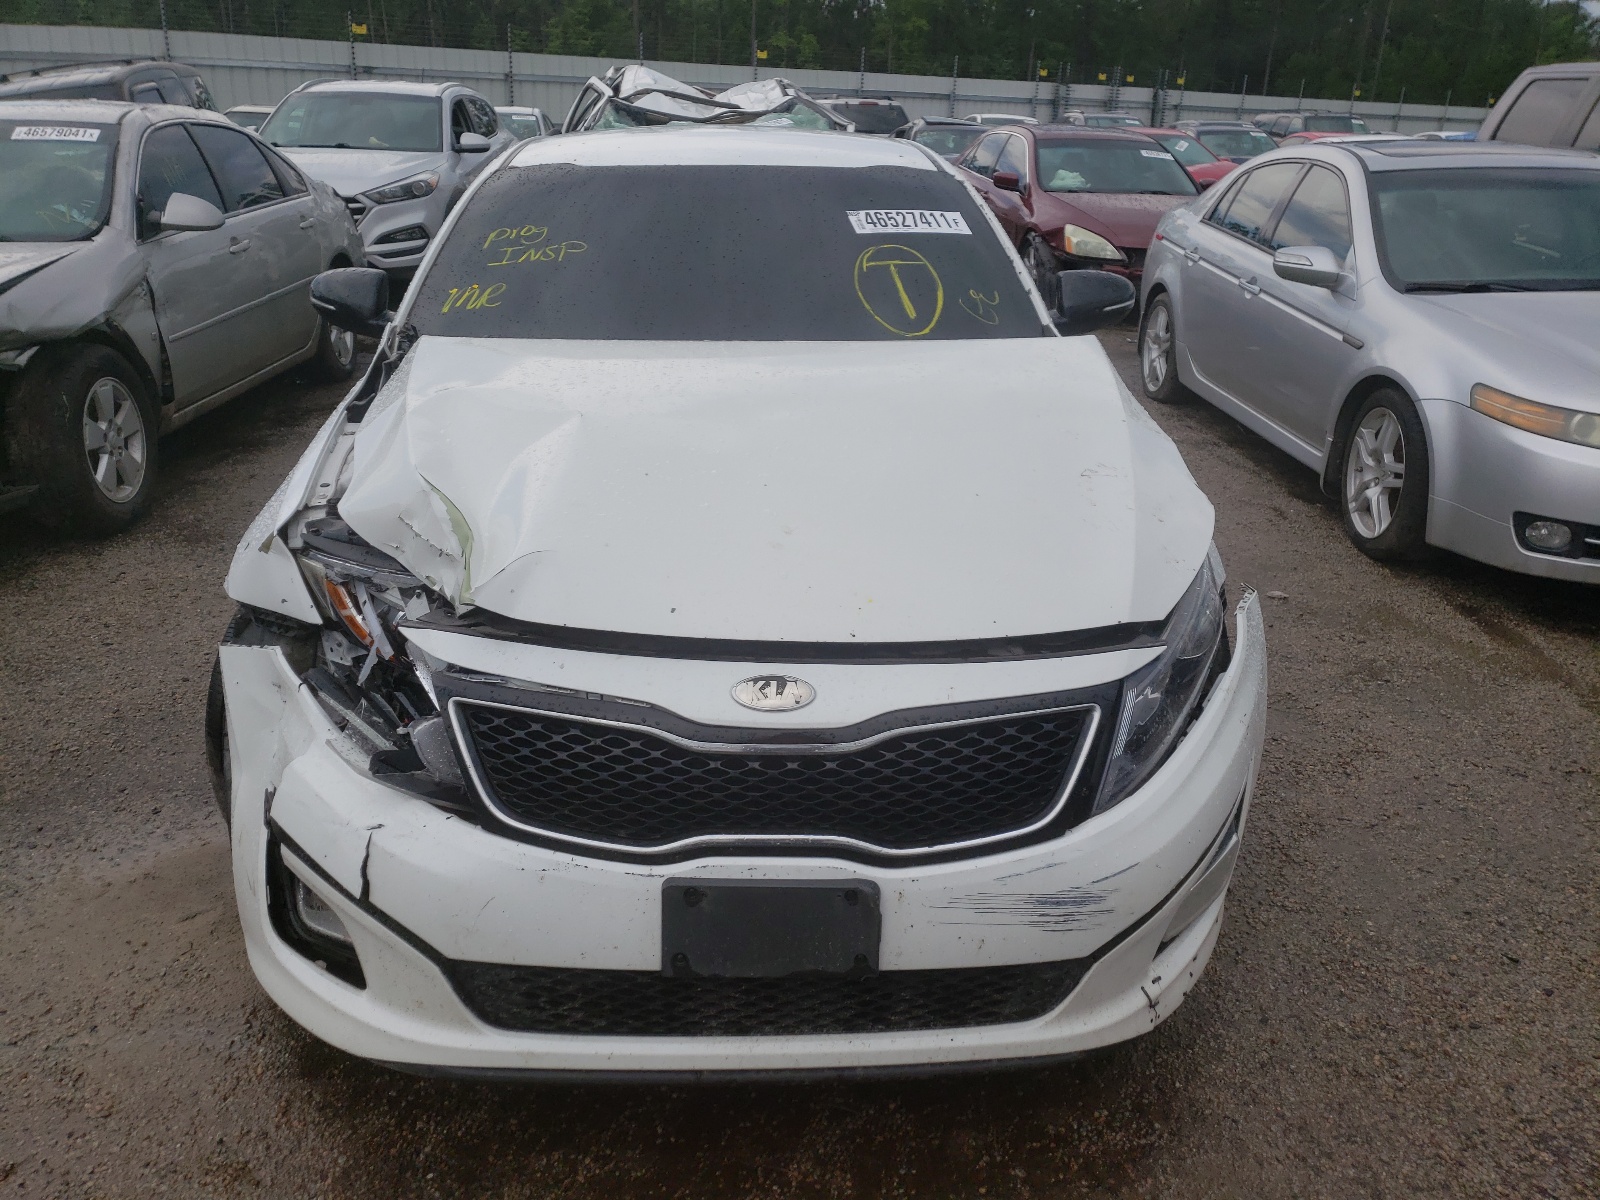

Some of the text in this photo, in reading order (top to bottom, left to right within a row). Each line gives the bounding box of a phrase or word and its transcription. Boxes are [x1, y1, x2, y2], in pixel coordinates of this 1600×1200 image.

[24, 127, 87, 138] 46579041
[865, 211, 952, 228] 46527411
[953, 218, 960, 227] F
[487, 241, 587, 266] INSP
[746, 680, 802, 704] KIA
